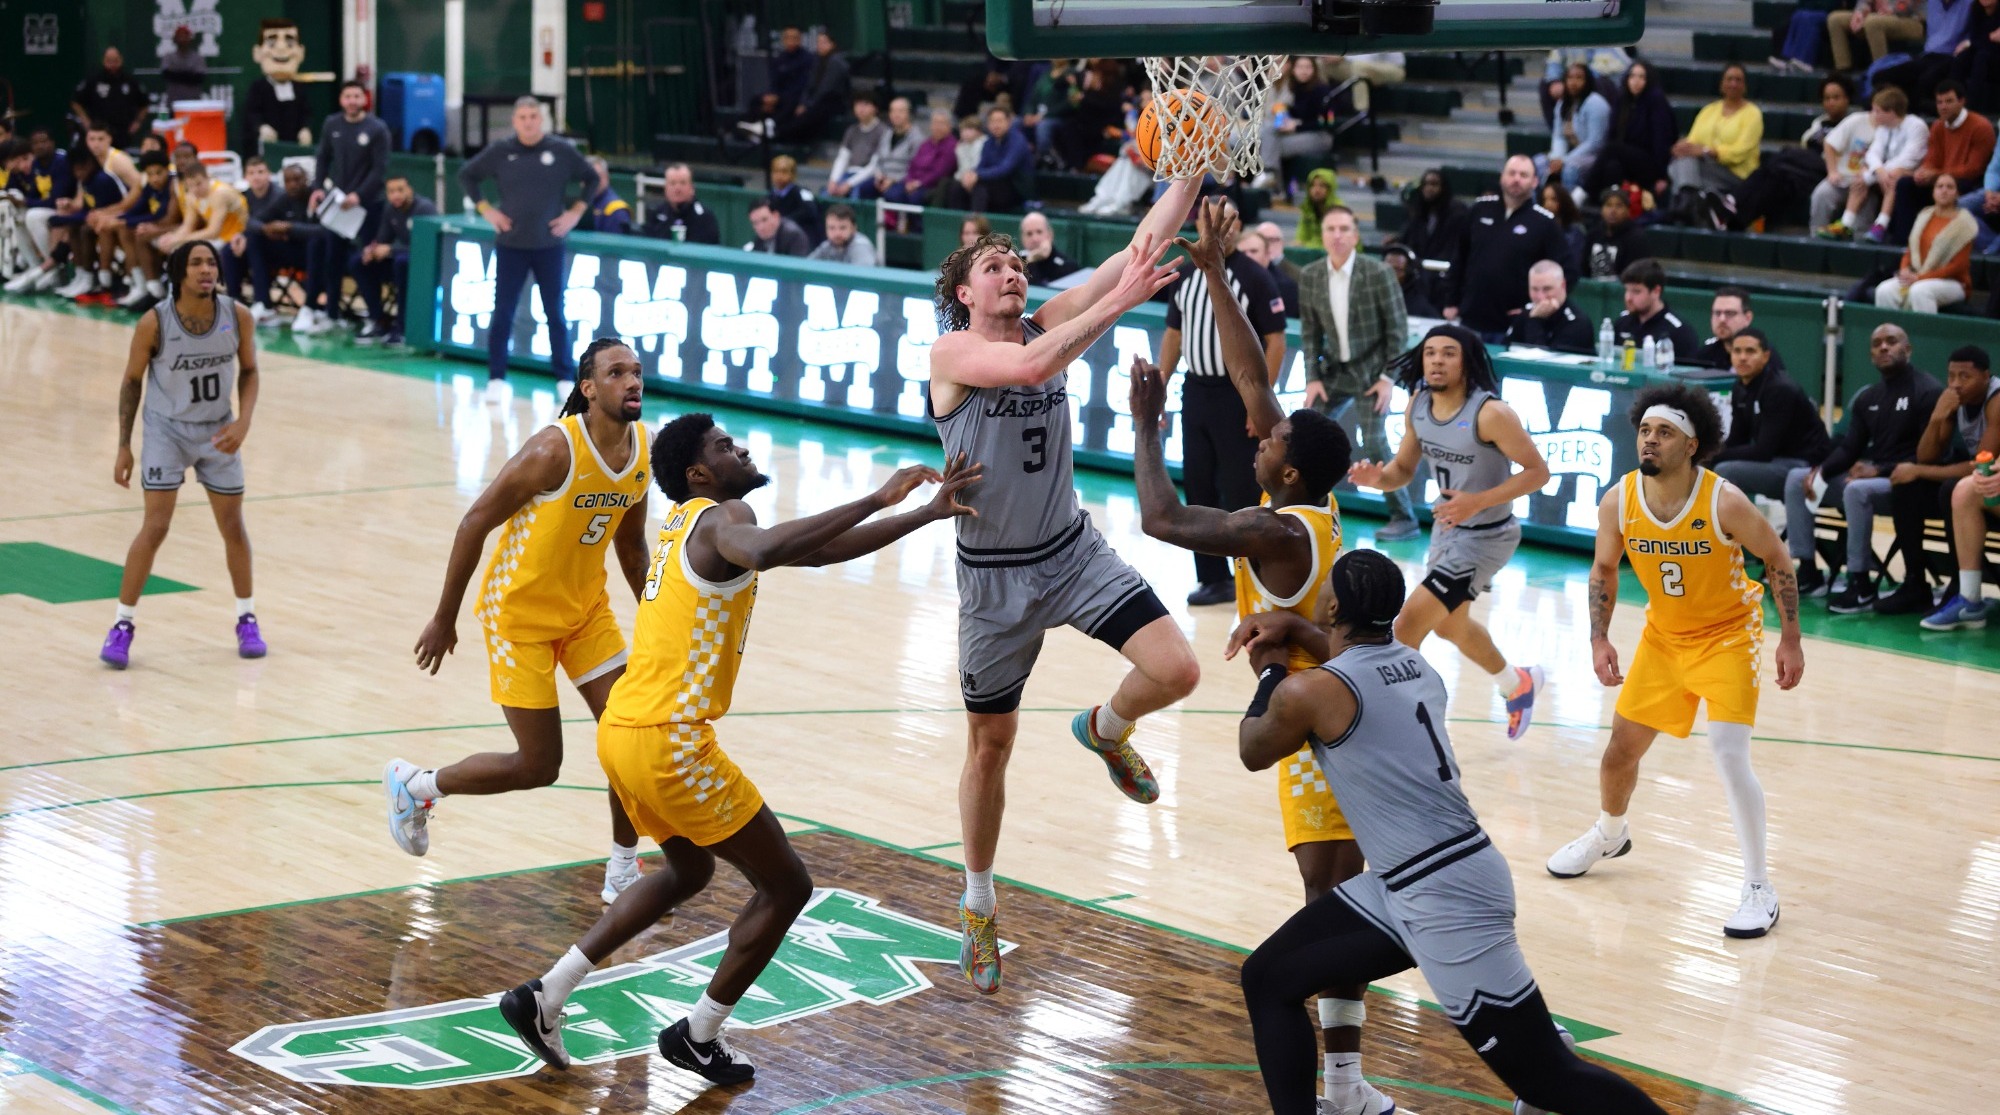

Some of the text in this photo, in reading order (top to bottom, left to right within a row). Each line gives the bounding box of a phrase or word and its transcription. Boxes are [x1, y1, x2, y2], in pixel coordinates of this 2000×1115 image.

[701, 271, 779, 393] M
[798, 284, 881, 410] M
[190, 373, 221, 403] 10
[1022, 427, 1047, 474] 3
[1421, 446, 1476, 465] ASPERS
[1538, 440, 1602, 466] PERS
[580, 513, 613, 545] 5
[1660, 561, 1685, 597] 2
[1376, 659, 1422, 686] ISAAC
[1415, 701, 1453, 782] 1
